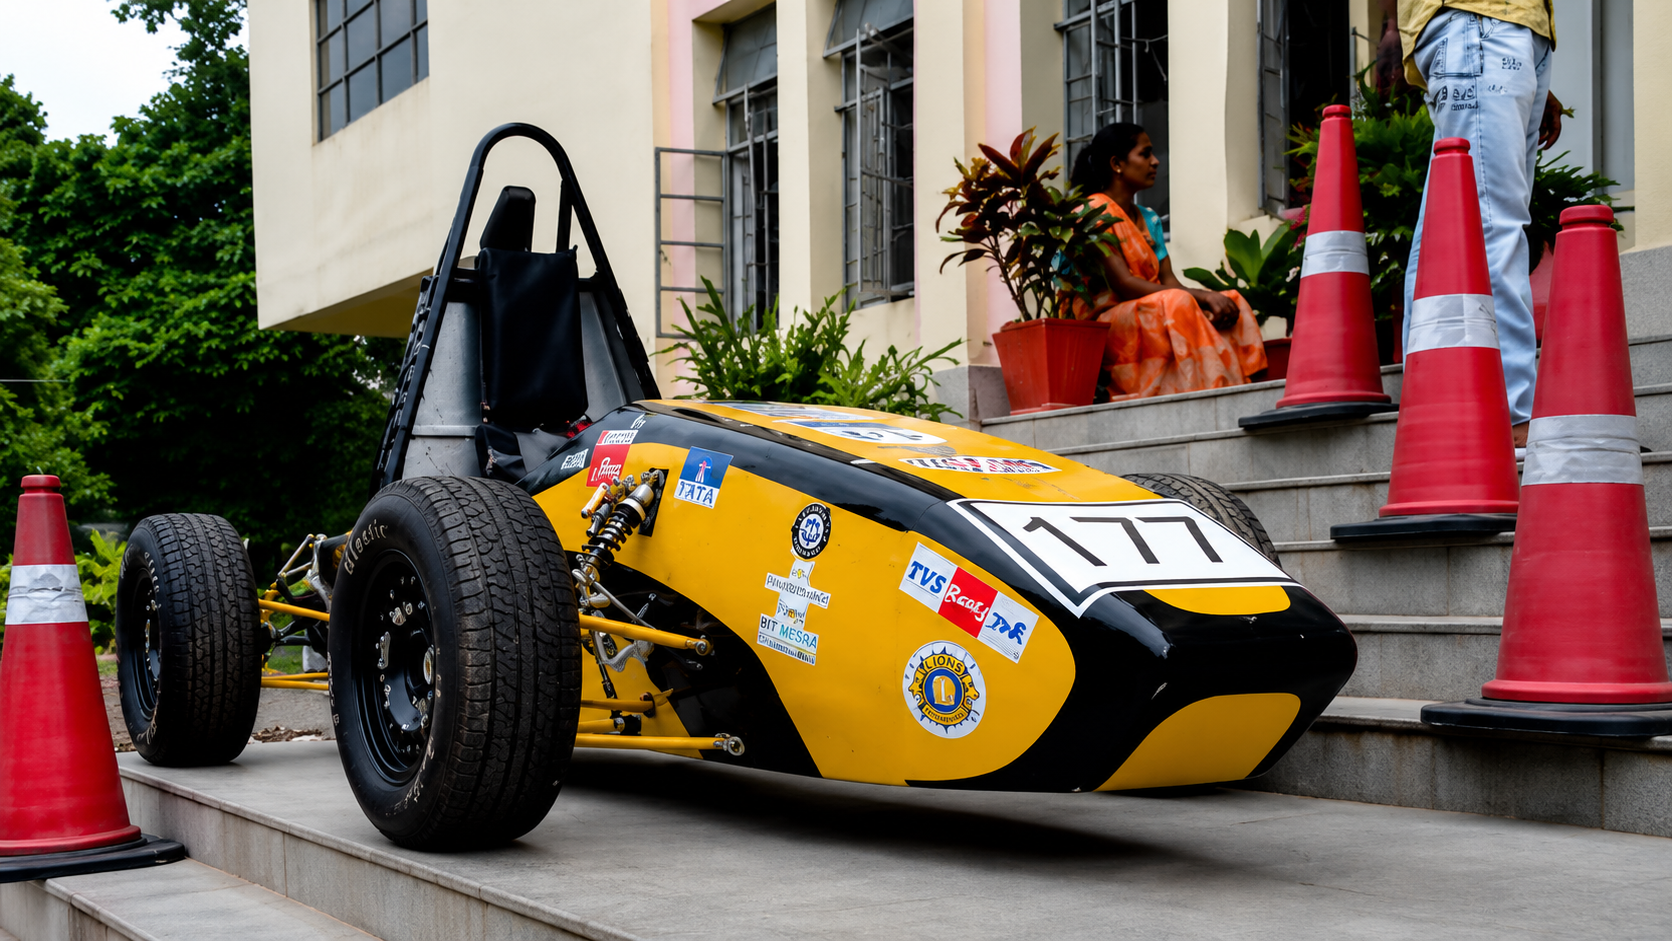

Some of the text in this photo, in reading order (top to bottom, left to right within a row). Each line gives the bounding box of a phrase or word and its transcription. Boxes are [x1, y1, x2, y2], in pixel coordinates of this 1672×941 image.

[678, 480, 714, 505] TATA
[1022, 516, 1224, 566] 177
[908, 560, 947, 594] TVS
[760, 615, 817, 649] BIT MESRA
[924, 655, 964, 674] LIONS
